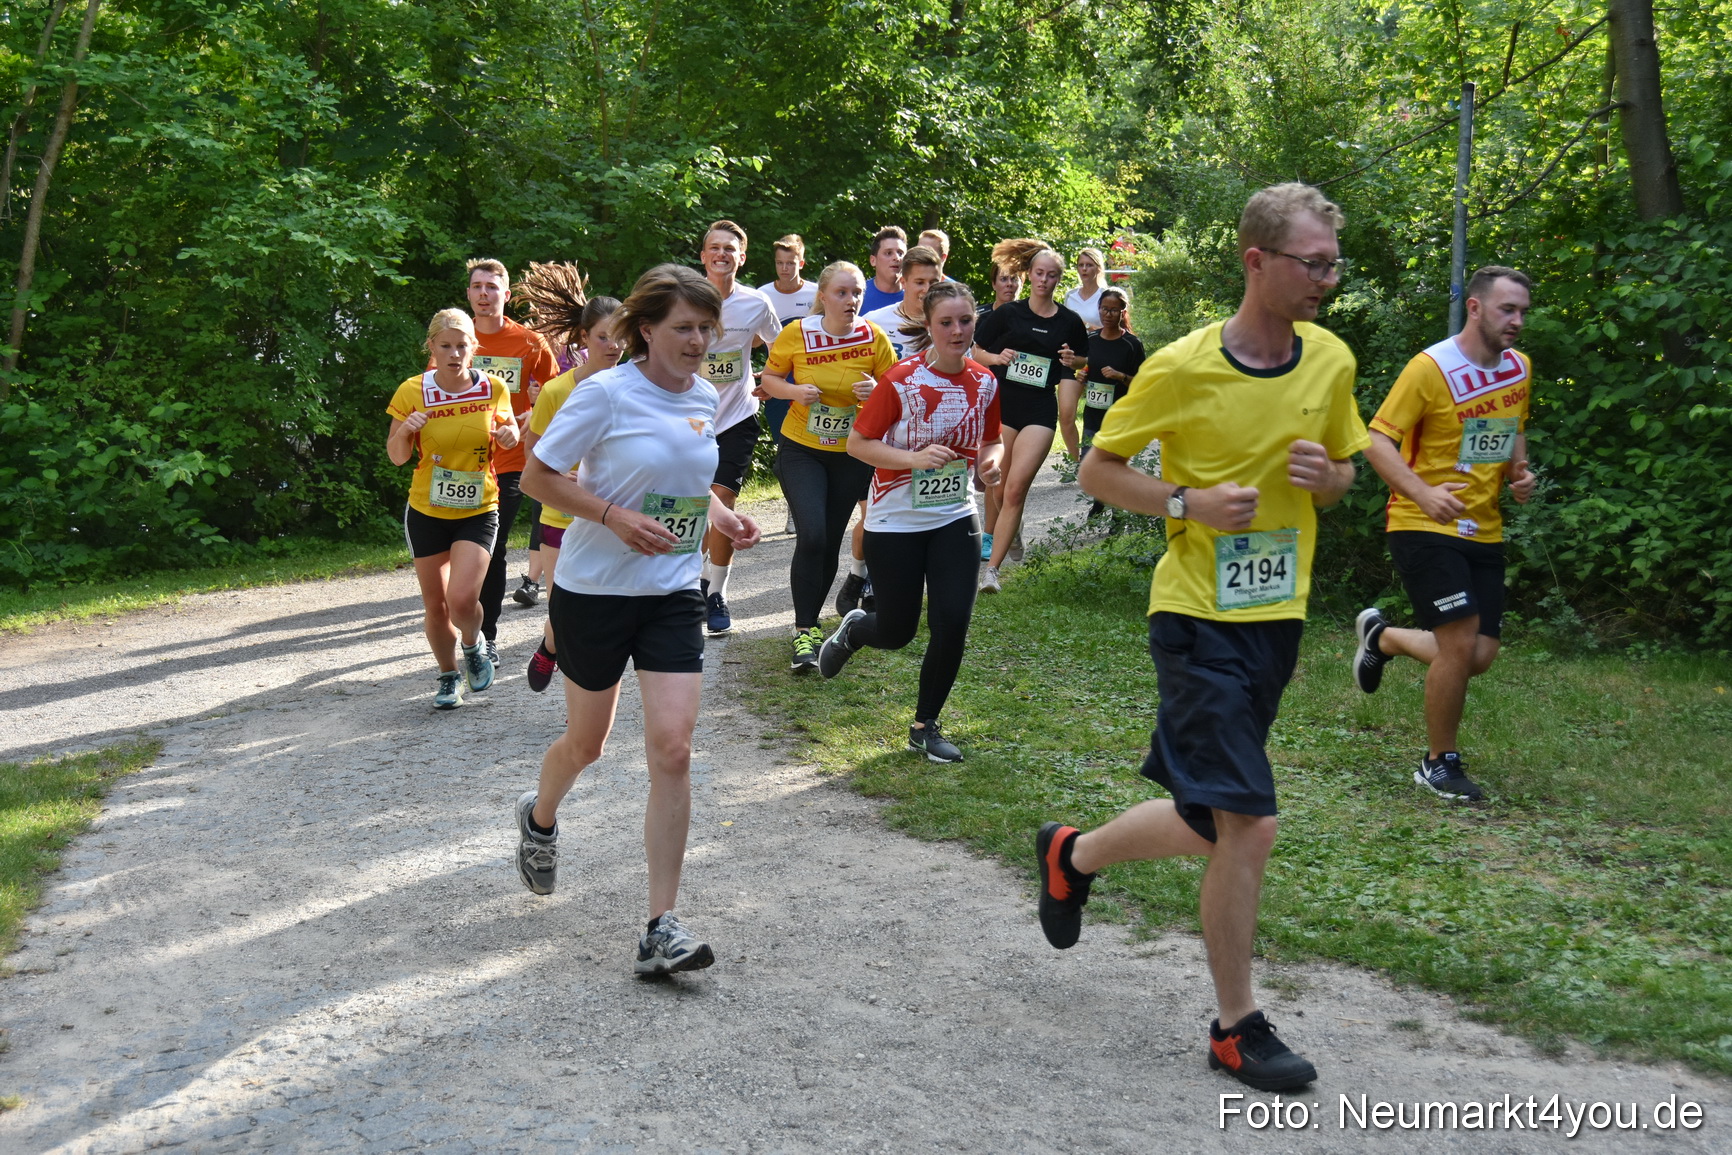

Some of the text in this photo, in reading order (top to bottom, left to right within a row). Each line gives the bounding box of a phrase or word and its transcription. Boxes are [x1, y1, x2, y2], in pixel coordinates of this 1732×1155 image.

[806, 347, 876, 366] MAX BÖGL
[708, 362, 734, 375] 348
[1014, 362, 1044, 378] 1986
[1088, 390, 1108, 403] 1971
[427, 403, 493, 420] MAX BÖGL
[1456, 399, 1499, 425] MAX
[814, 415, 850, 430] 1675
[1468, 434, 1511, 451] 1657
[437, 481, 477, 499] 1589
[919, 475, 961, 496] 2225
[655, 516, 698, 538] 351
[1226, 555, 1287, 589] 2194
